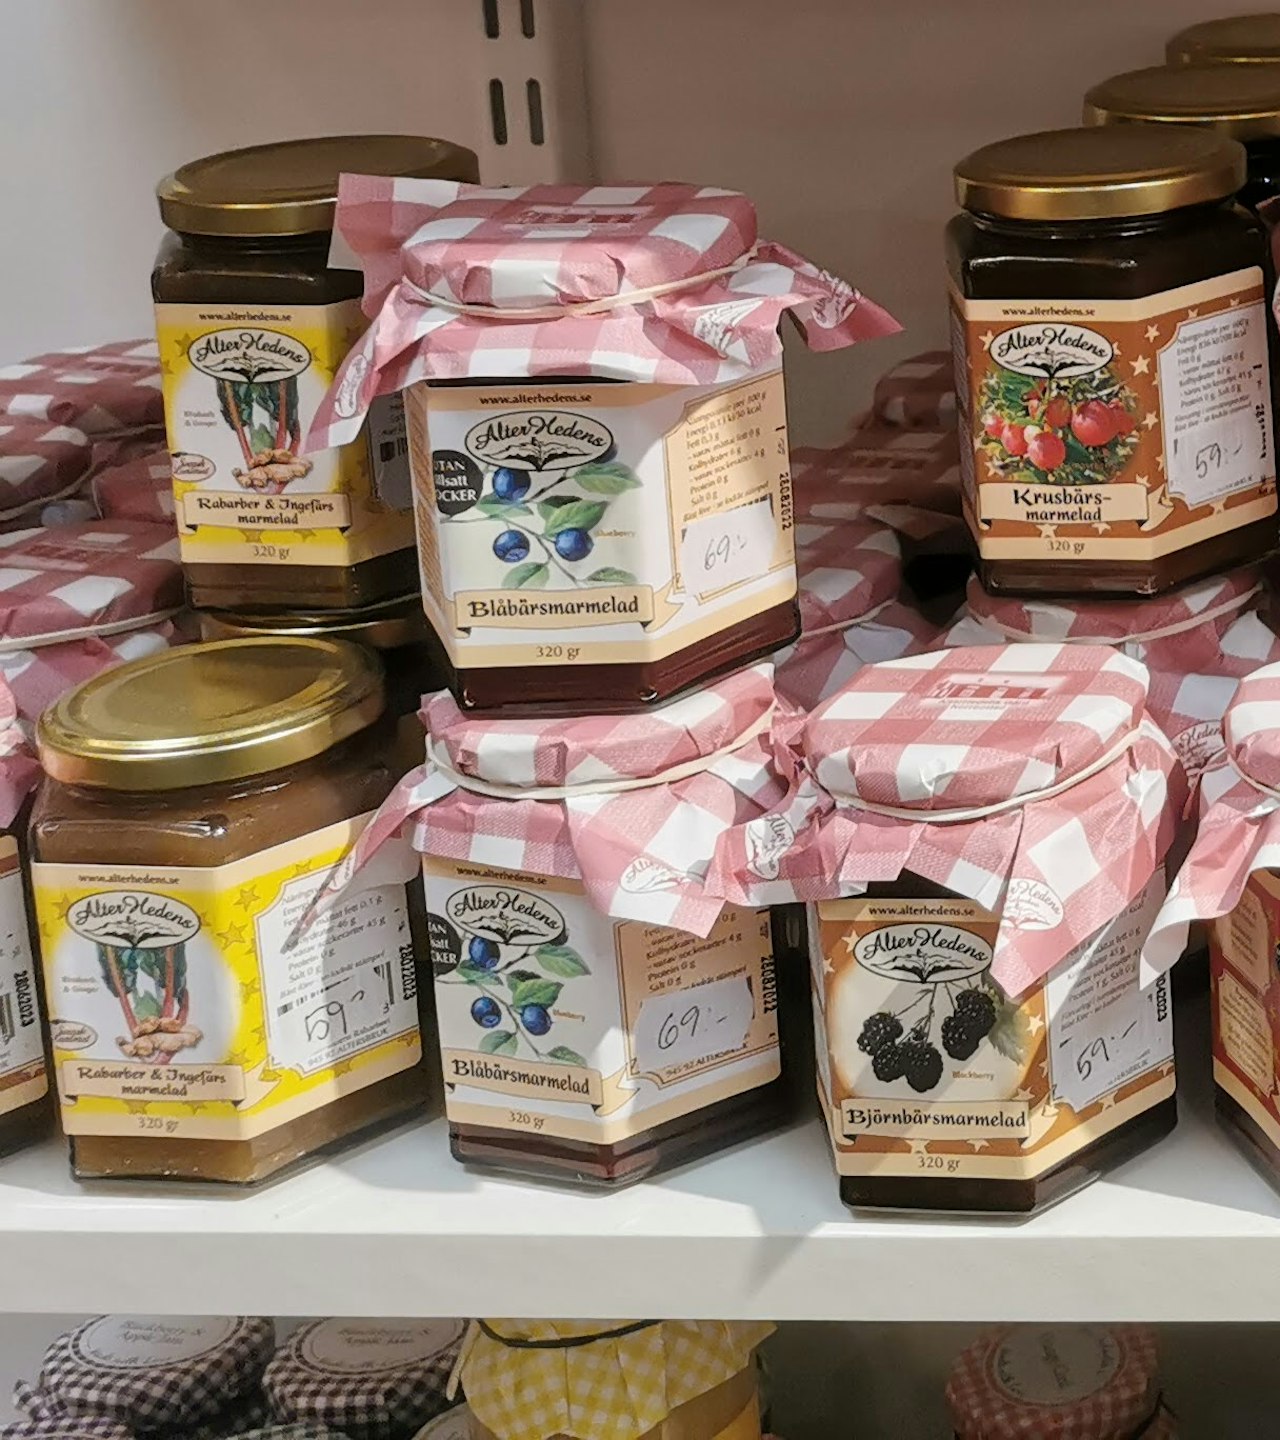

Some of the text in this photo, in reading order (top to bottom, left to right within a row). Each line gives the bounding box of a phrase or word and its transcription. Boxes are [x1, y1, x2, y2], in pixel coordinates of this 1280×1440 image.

[475, 415, 606, 450] Alter Hedens
[197, 497, 260, 510] Rabarber
[265, 499, 274, 509] &
[237, 513, 298, 525] marmelad
[1026, 508, 1101, 521] marmelad
[468, 596, 639, 618] Blåbärsmarmelad
[536, 646, 581, 660] 320 gr
[451, 1059, 590, 1095] Blåbärsmarmelad
[846, 1109, 1026, 1131] Björnbärsmarmelad
